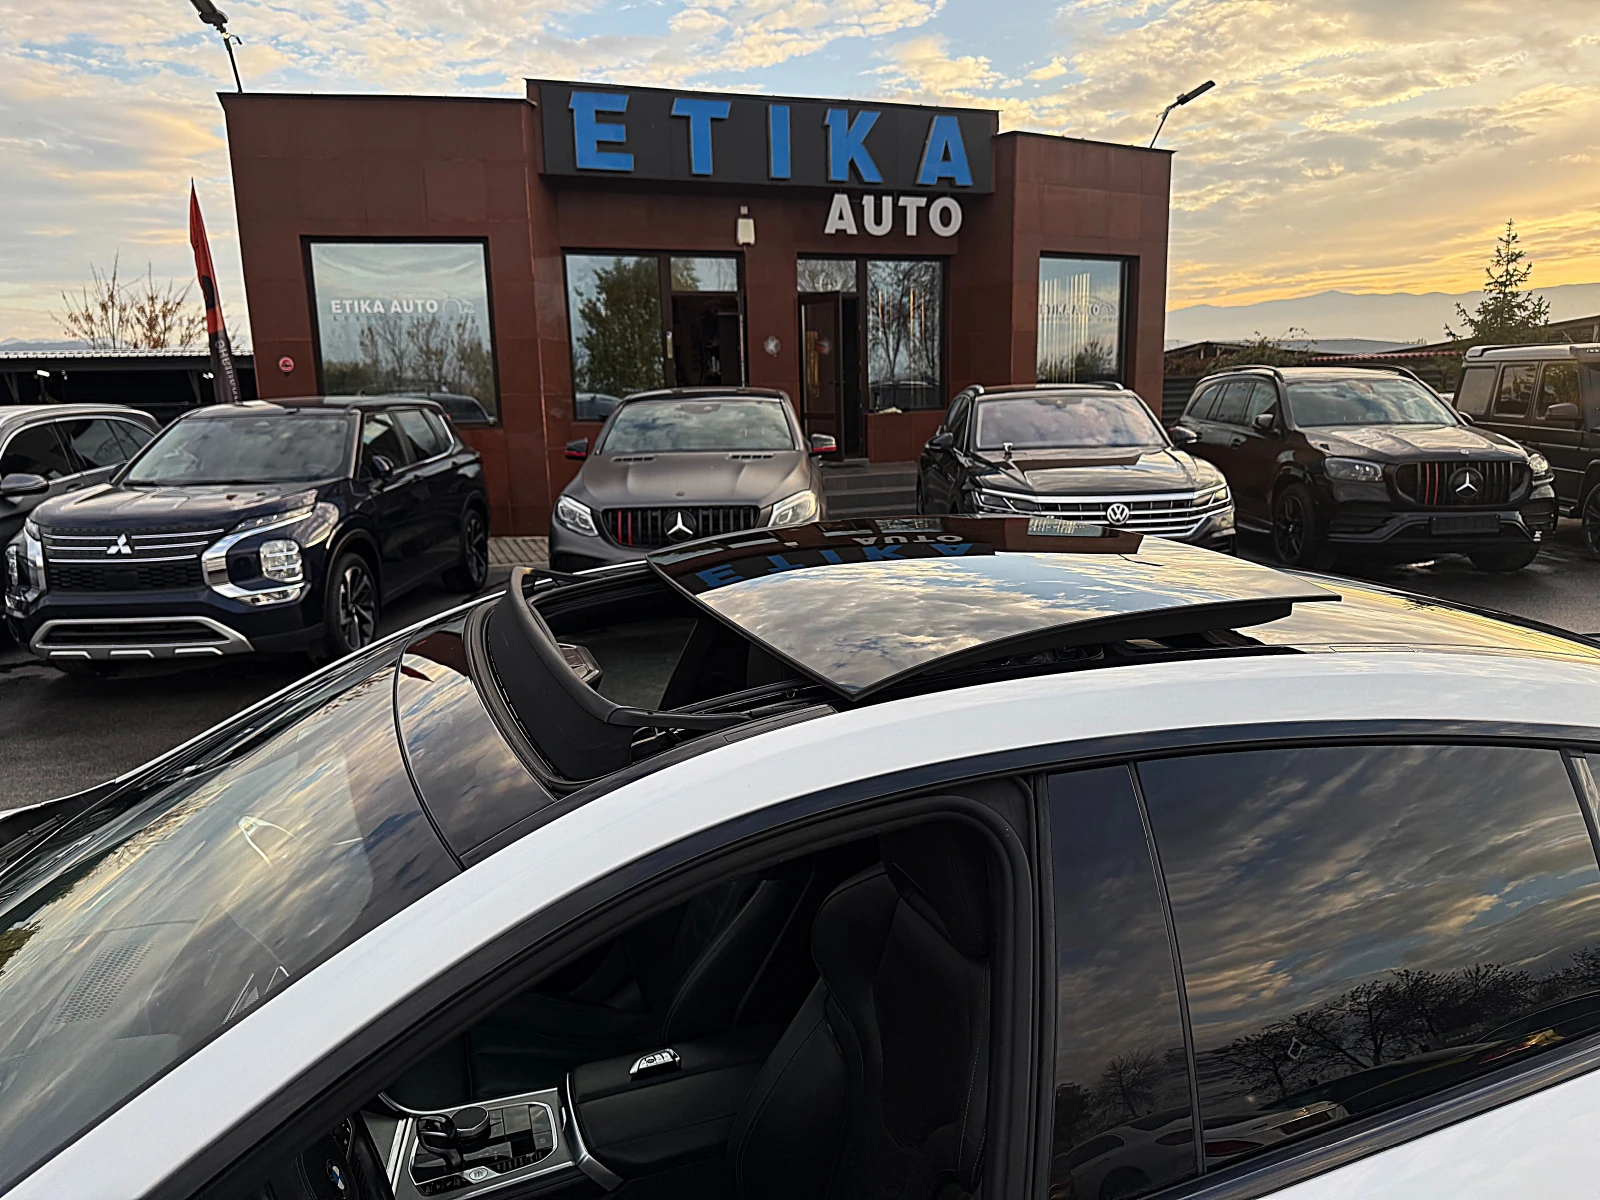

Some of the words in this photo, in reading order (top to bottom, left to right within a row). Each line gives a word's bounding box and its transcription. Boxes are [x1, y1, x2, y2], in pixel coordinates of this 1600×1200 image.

[569, 91, 973, 187] ETIKA
[824, 193, 963, 237] AUTO
[330, 299, 385, 314] ETIKA
[390, 299, 439, 314] AUTO
